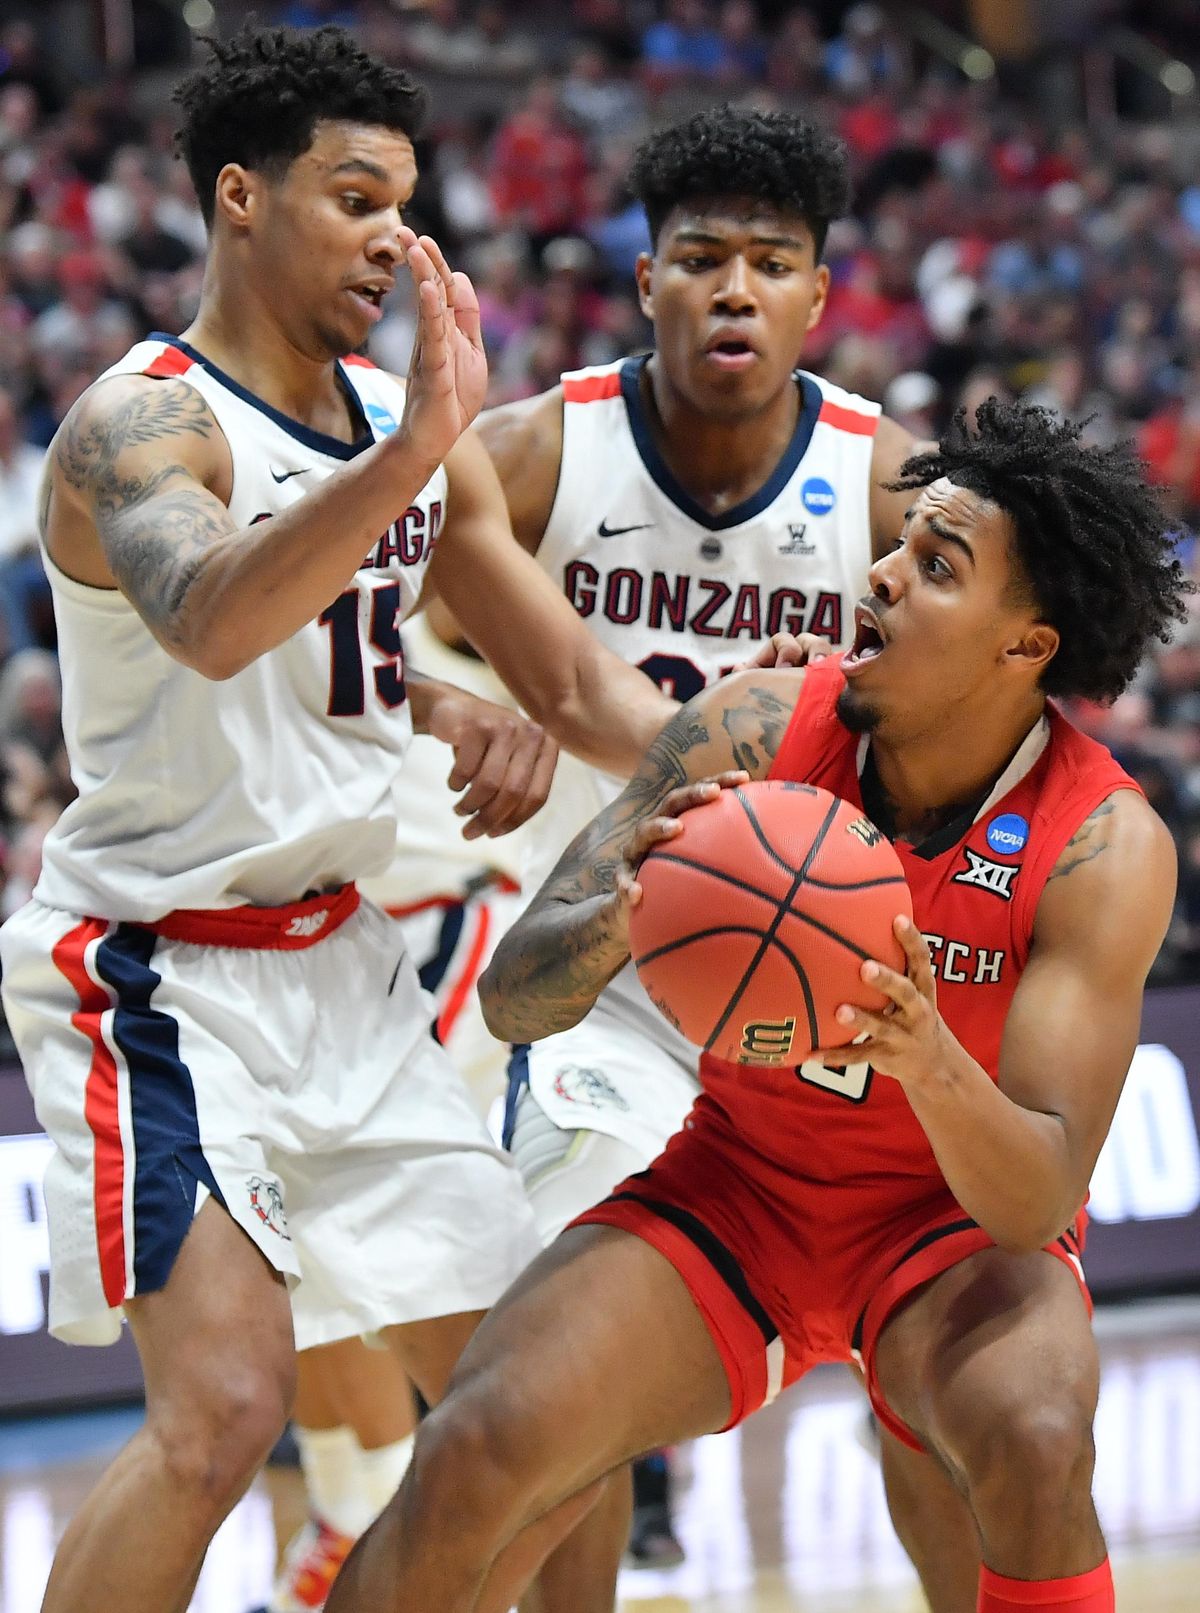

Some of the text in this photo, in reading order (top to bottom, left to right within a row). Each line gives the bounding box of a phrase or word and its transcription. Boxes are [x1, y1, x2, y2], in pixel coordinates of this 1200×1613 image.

[564, 559, 843, 645] GONZAGA
[317, 580, 407, 717] 15
[990, 828, 1025, 848] NCAA
[919, 932, 1005, 985] ECH
